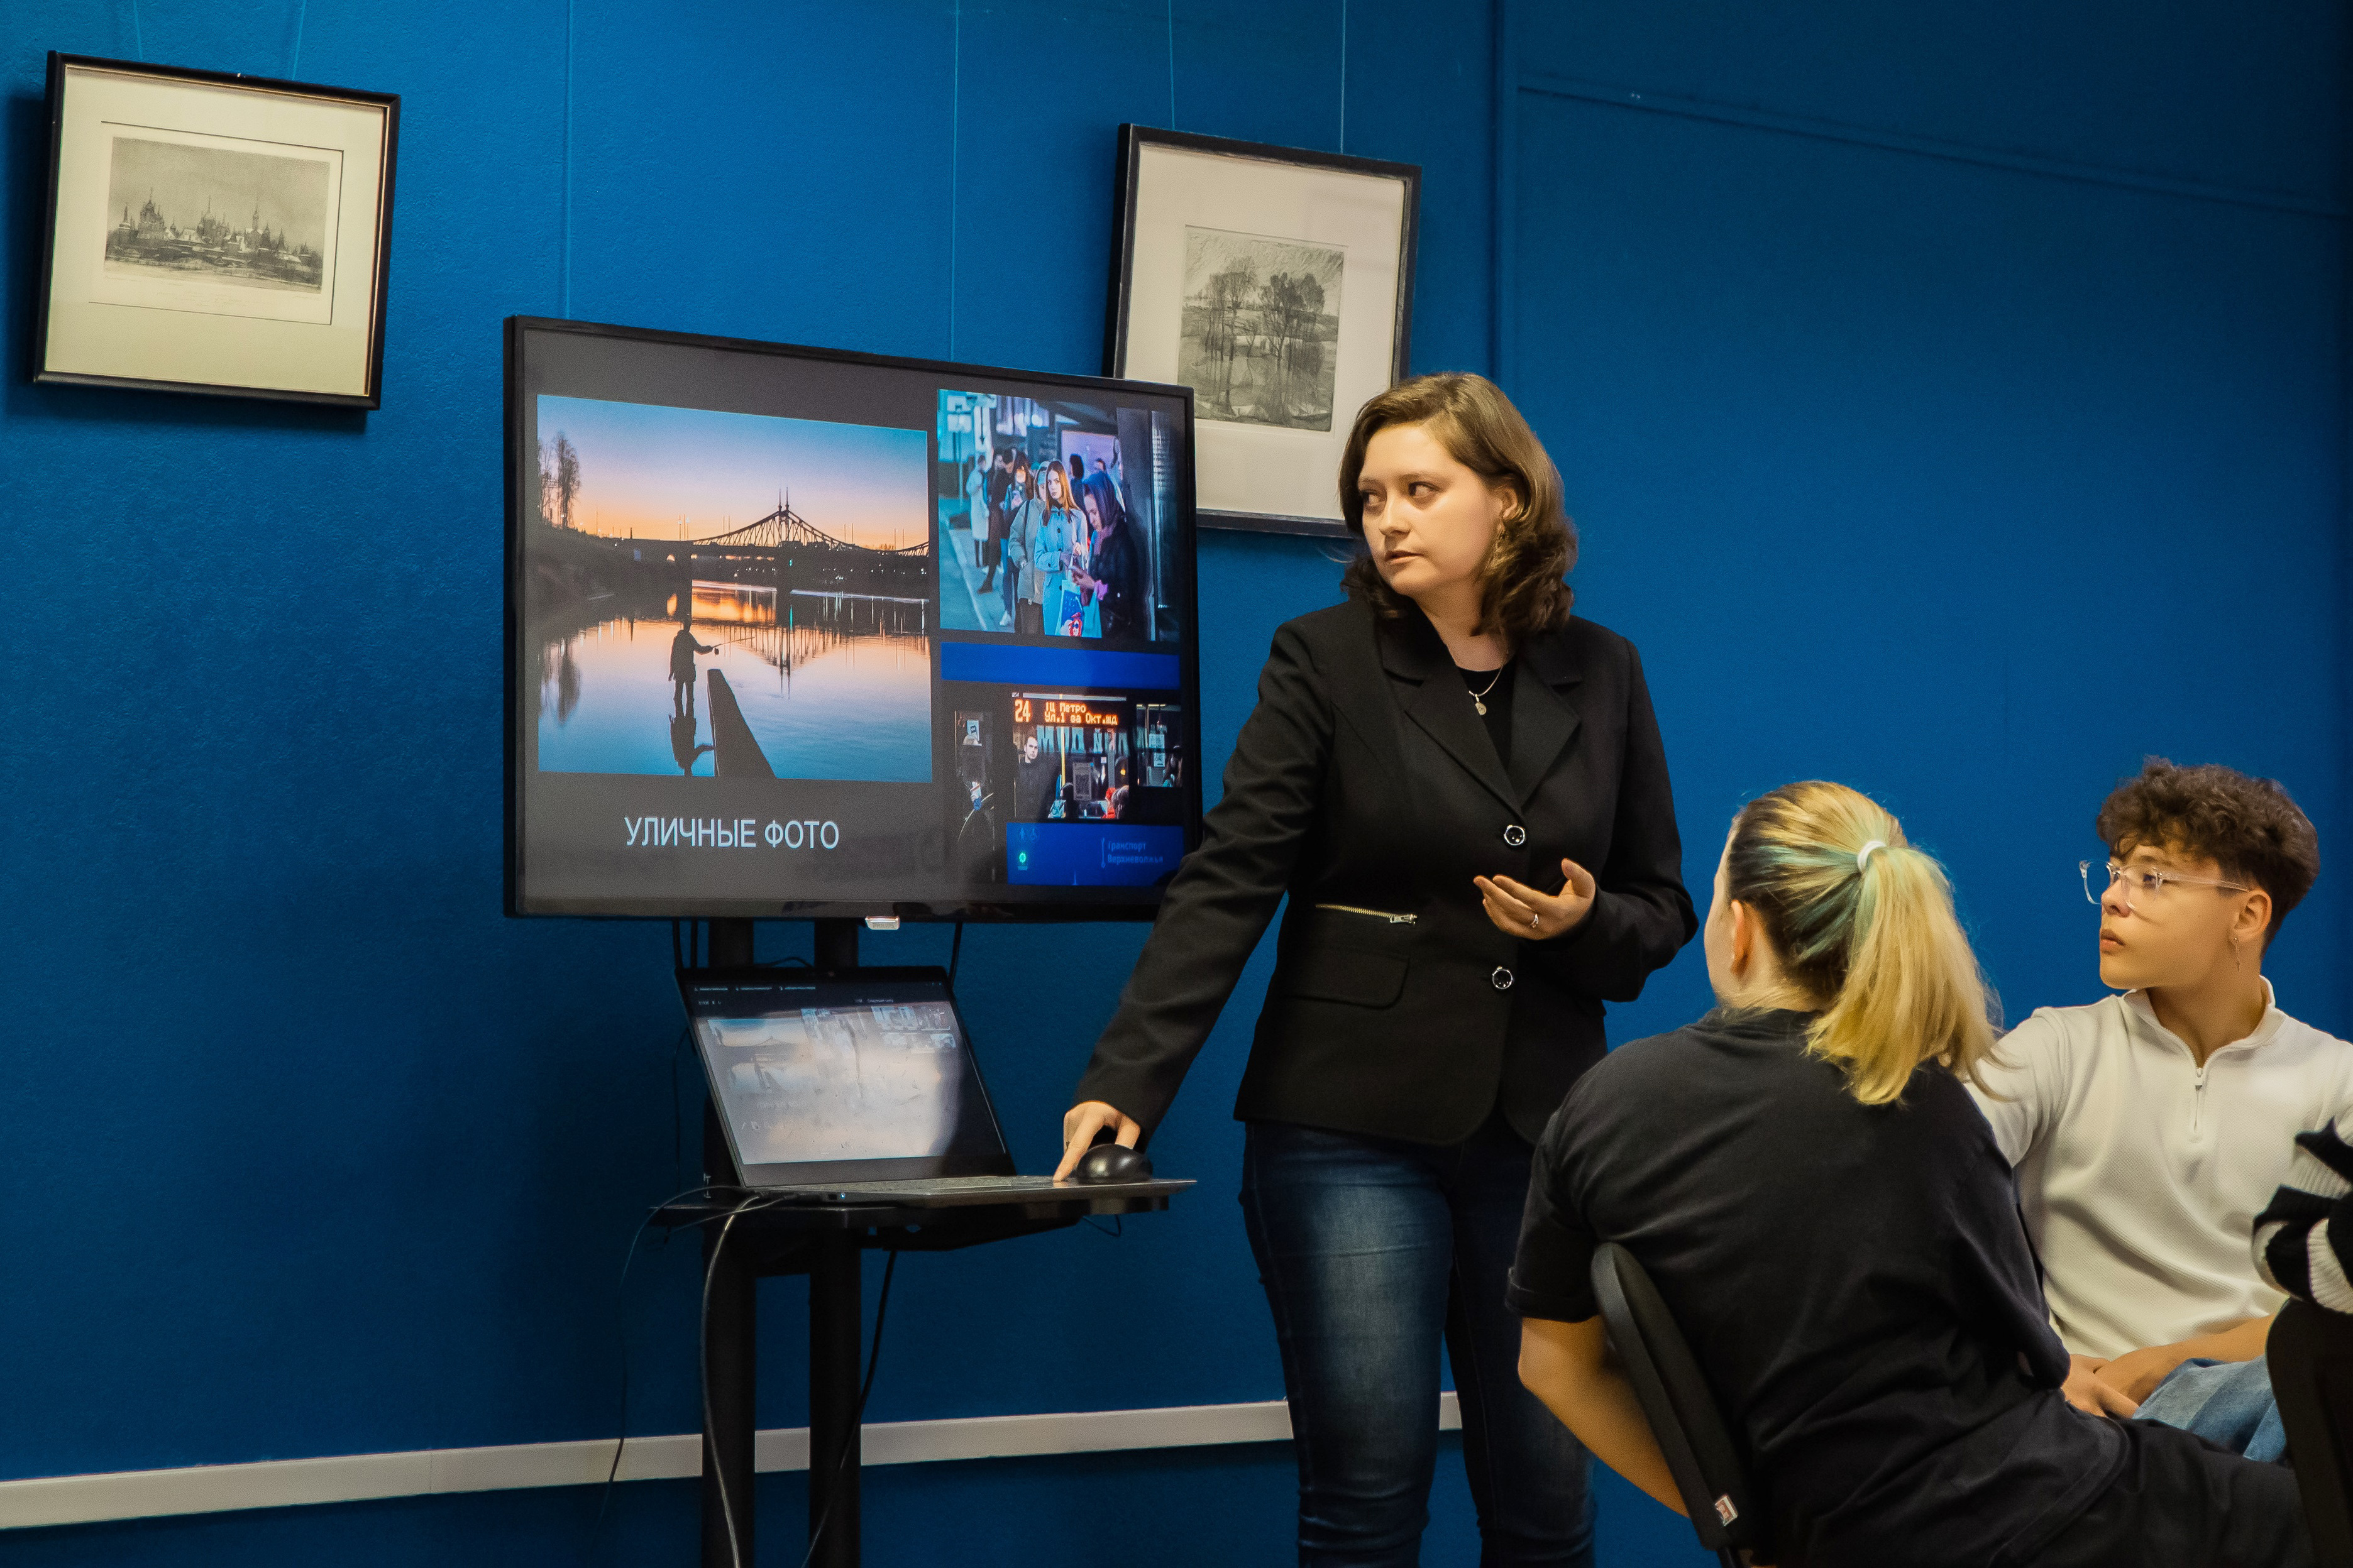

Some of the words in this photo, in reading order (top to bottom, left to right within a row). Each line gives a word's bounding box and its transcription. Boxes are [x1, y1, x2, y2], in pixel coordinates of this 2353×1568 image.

[1015, 699, 1031, 723] 24
[1059, 702, 1086, 714] Петро
[624, 817, 756, 848] УЛИЧНЫЕ
[764, 820, 839, 849] ФОТО
[1108, 841, 1147, 852] Транспорт
